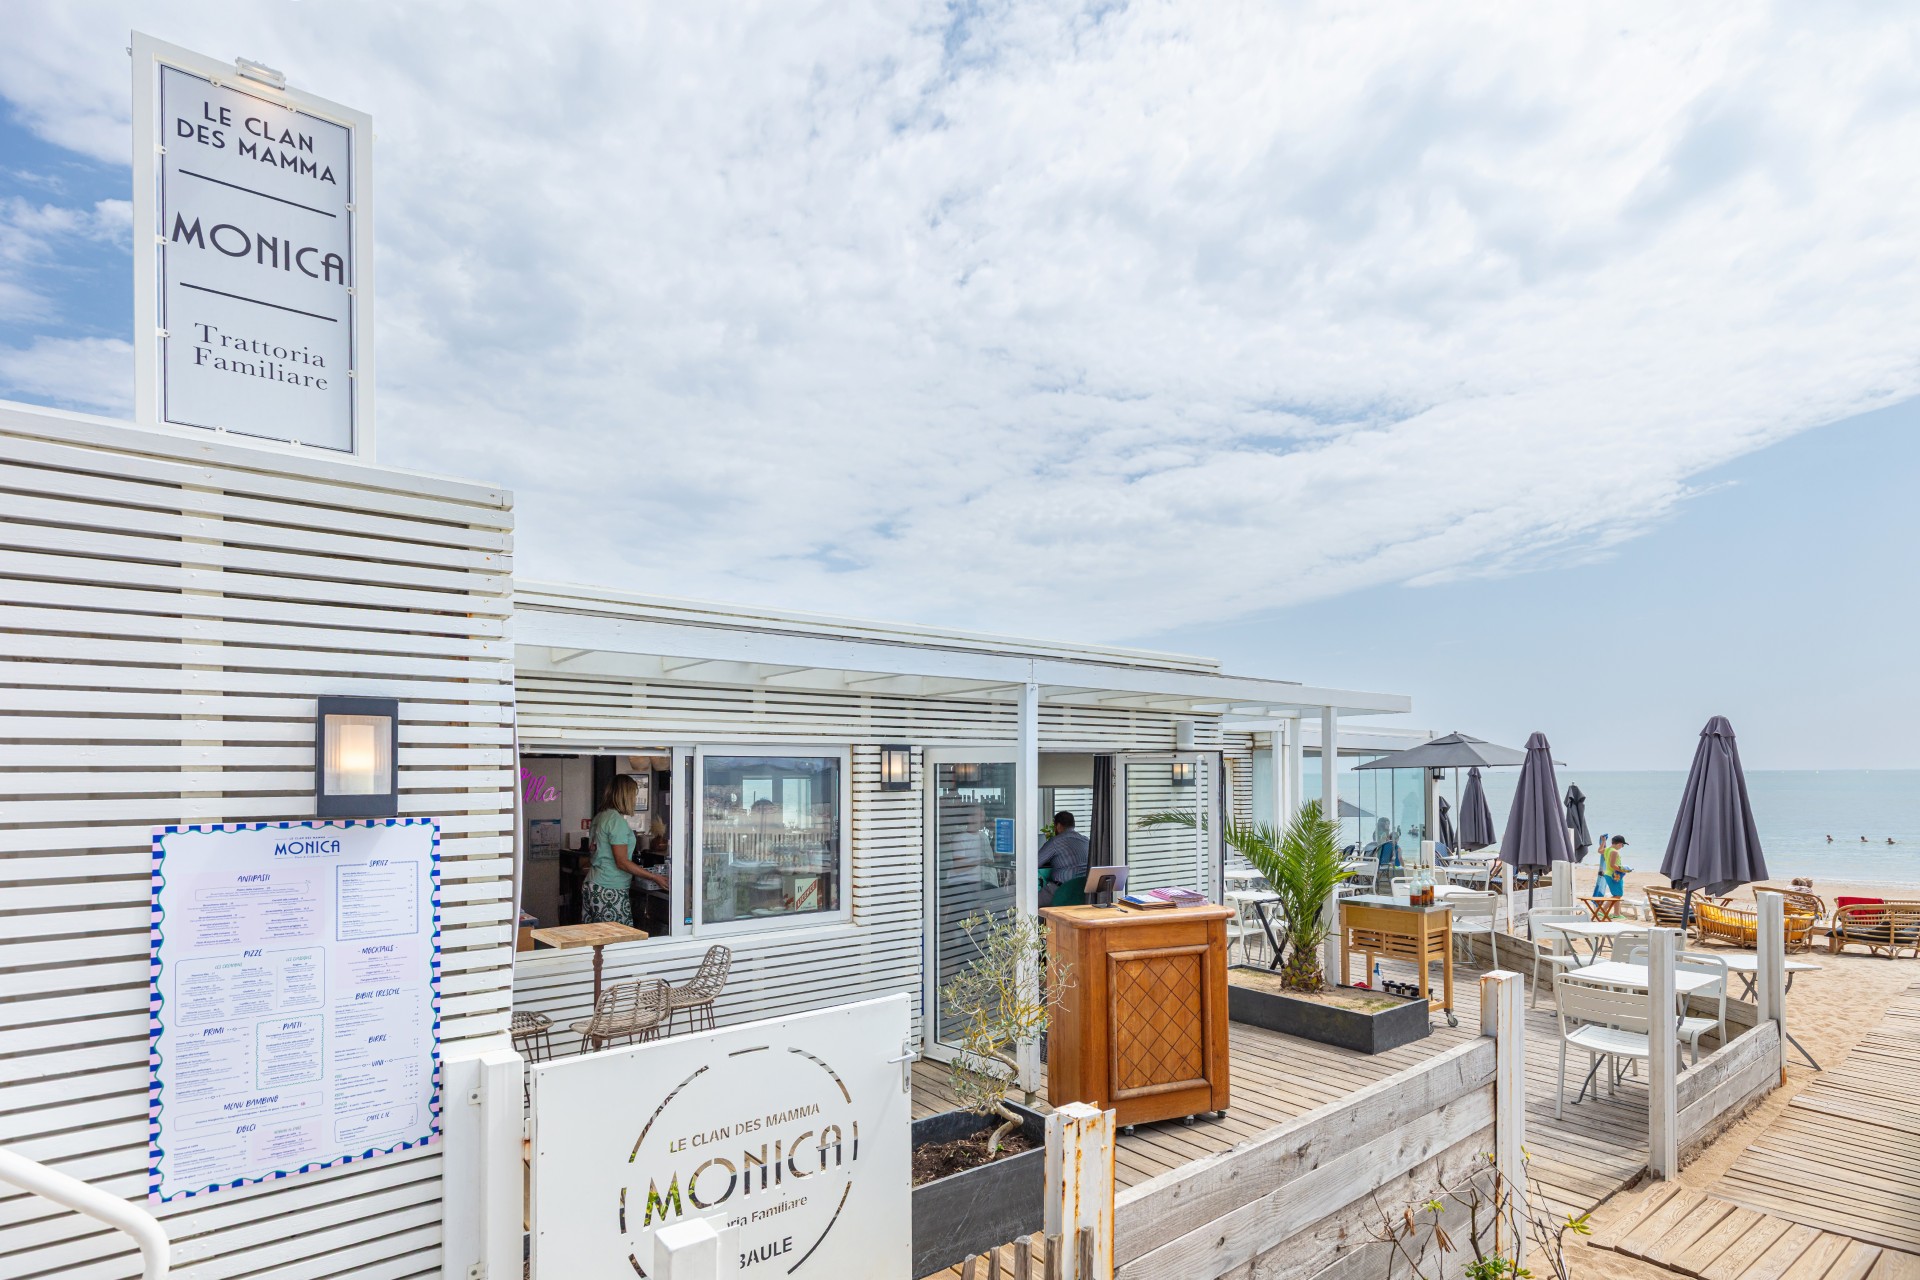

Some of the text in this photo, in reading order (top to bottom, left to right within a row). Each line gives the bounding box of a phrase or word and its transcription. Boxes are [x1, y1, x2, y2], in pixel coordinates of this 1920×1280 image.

[204, 102, 314, 153] LE CLAN
[177, 118, 337, 185] DES MAMMA
[172, 211, 344, 285] MONICA
[194, 322, 326, 369] Trattoria
[193, 346, 328, 391] Familiare
[274, 840, 340, 856] MONICA
[369, 859, 389, 867] SPRITZ
[237, 873, 271, 883] ANTIPASTI
[243, 949, 263, 958] PIZZE
[362, 944, 394, 955] MOCKTAILS
[203, 1027, 225, 1037] PRIMI
[368, 1034, 388, 1044] BIRRE
[223, 1095, 279, 1111] MENU BAMBINO
[236, 1123, 257, 1134] DOLCI
[669, 1102, 821, 1154] LE CLAN DES MAMMA
[643, 1125, 842, 1231] MONICA
[751, 1196, 808, 1223] Familiare
